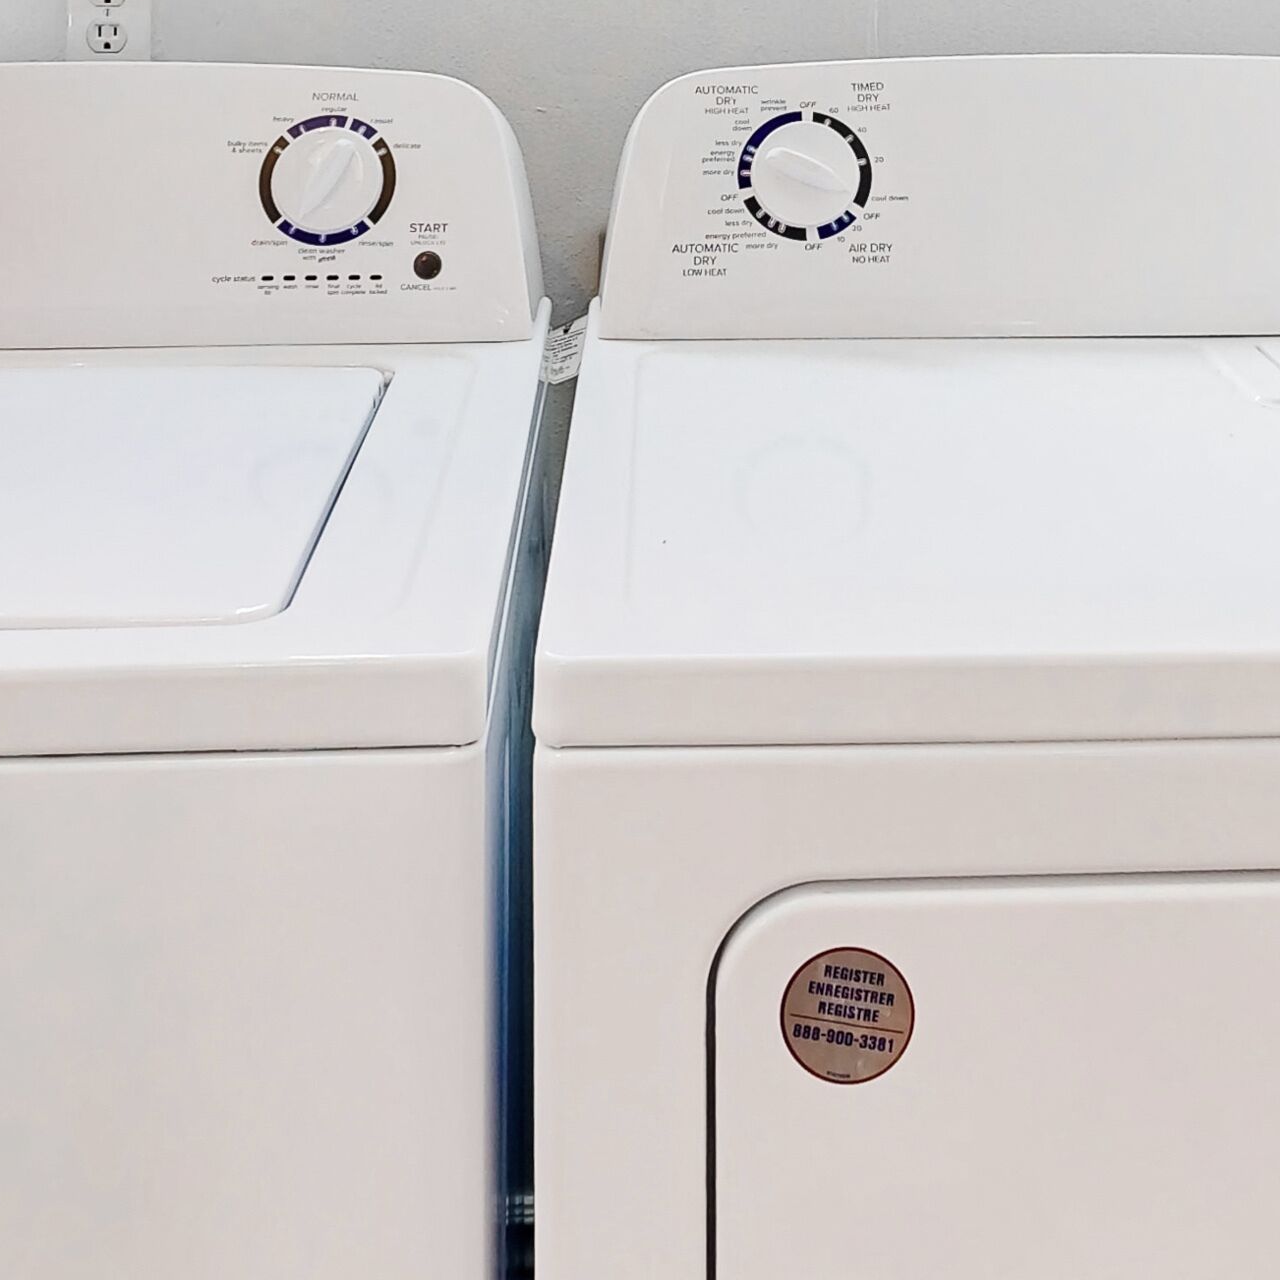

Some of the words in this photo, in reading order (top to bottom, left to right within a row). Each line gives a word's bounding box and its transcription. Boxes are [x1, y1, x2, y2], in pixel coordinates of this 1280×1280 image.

[694, 85, 759, 95] AUTOMATIC
[851, 82, 884, 92] TIMED
[311, 92, 359, 102] NORMAL
[715, 96, 737, 106] DRY
[857, 93, 880, 103] DRY
[799, 101, 817, 109] OFF
[869, 103, 891, 112] HEAT
[704, 107, 726, 115] HIGH
[727, 107, 749, 115] HEAT
[723, 169, 735, 177] dry
[409, 223, 449, 233] START
[732, 232, 767, 240] preferred
[671, 243, 739, 254] AUTOMATIC
[766, 242, 779, 250] dry
[804, 243, 824, 251] OFF
[848, 243, 868, 253] AIR
[870, 243, 893, 253] DRY
[693, 255, 717, 266] DRY
[852, 255, 866, 264] NO
[867, 255, 891, 264] HEAT
[682, 268, 703, 277] LOW
[704, 268, 727, 277] HEAT
[211, 275, 232, 283] cycle
[400, 283, 432, 291] CANCEL
[824, 964, 885, 987] REGISTER
[808, 980, 895, 1007] ENREGISTRER
[818, 1001, 880, 1023] REGISTRE
[792, 1023, 894, 1053] 888-900-3381
